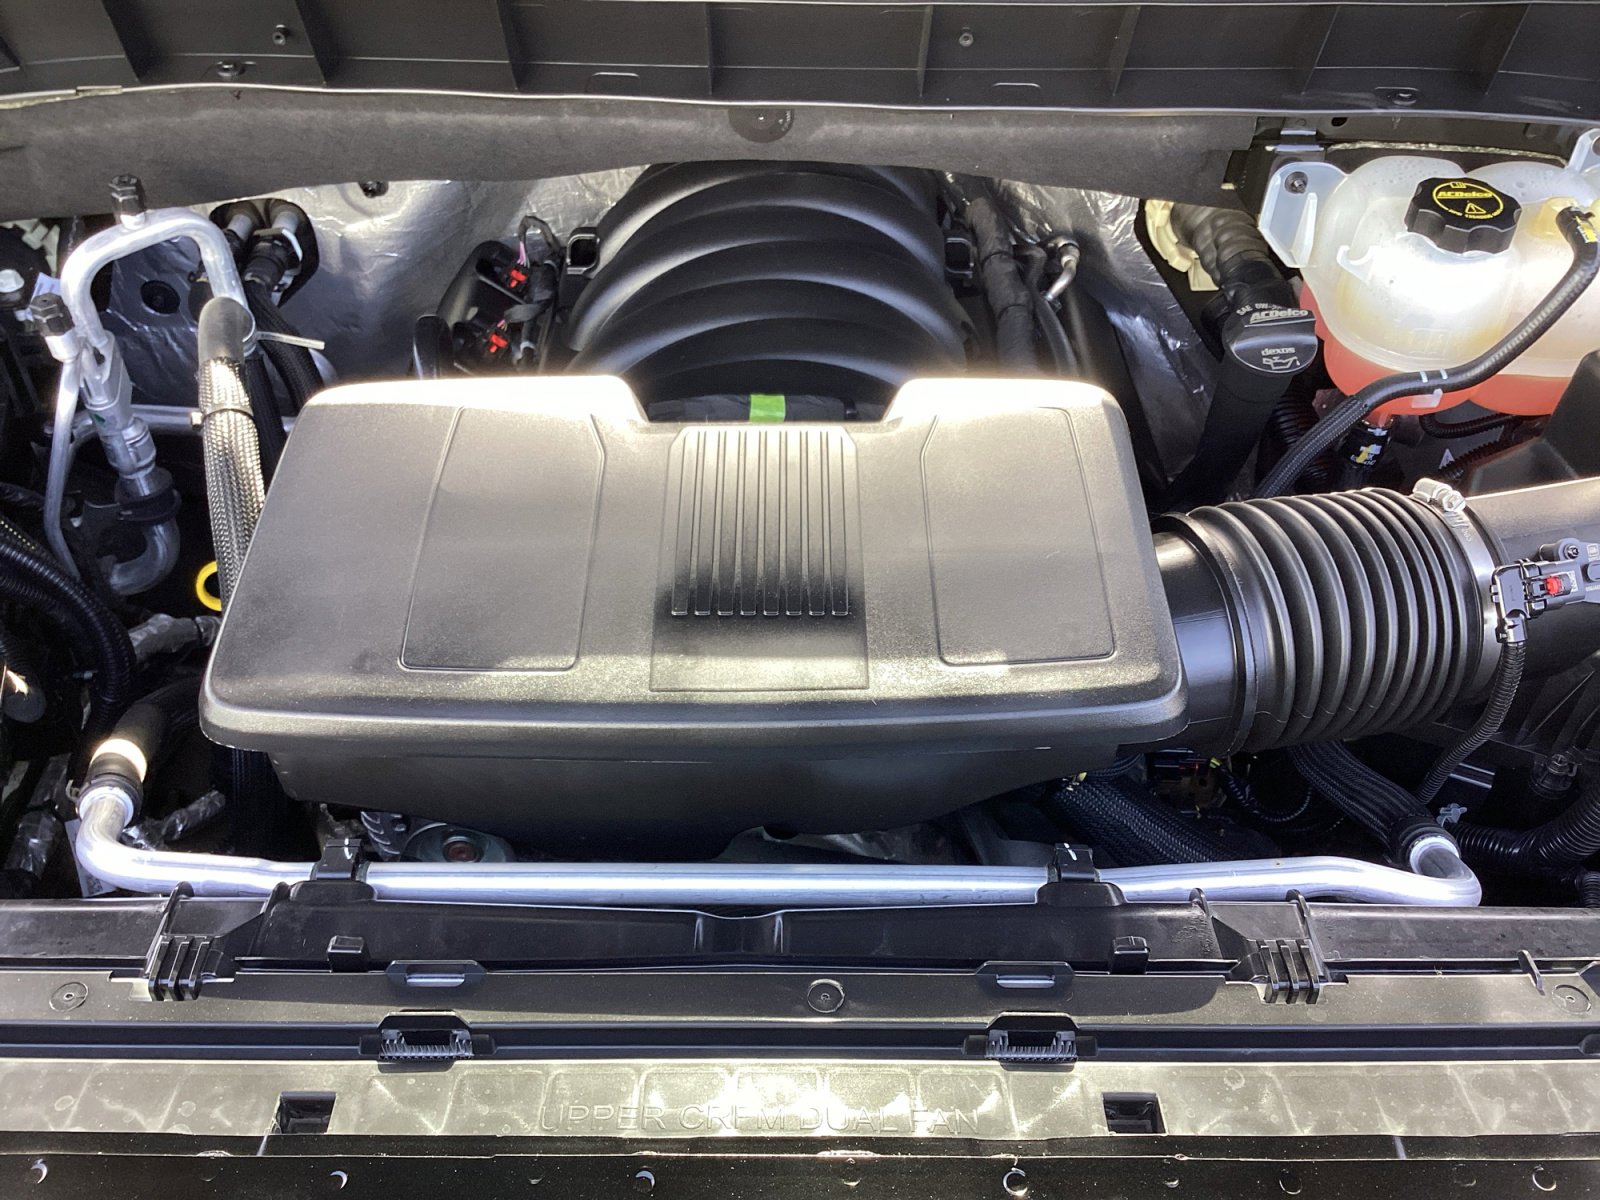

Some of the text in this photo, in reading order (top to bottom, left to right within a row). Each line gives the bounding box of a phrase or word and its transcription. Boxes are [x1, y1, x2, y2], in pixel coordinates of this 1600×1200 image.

[1236, 305, 1253, 316] SAE
[1249, 308, 1309, 324] ACDelco
[1261, 347, 1295, 356] dexos
[540, 1104, 667, 1130] UPPER
[800, 1107, 898, 1132] DUAL
[911, 1108, 979, 1135] FAN
